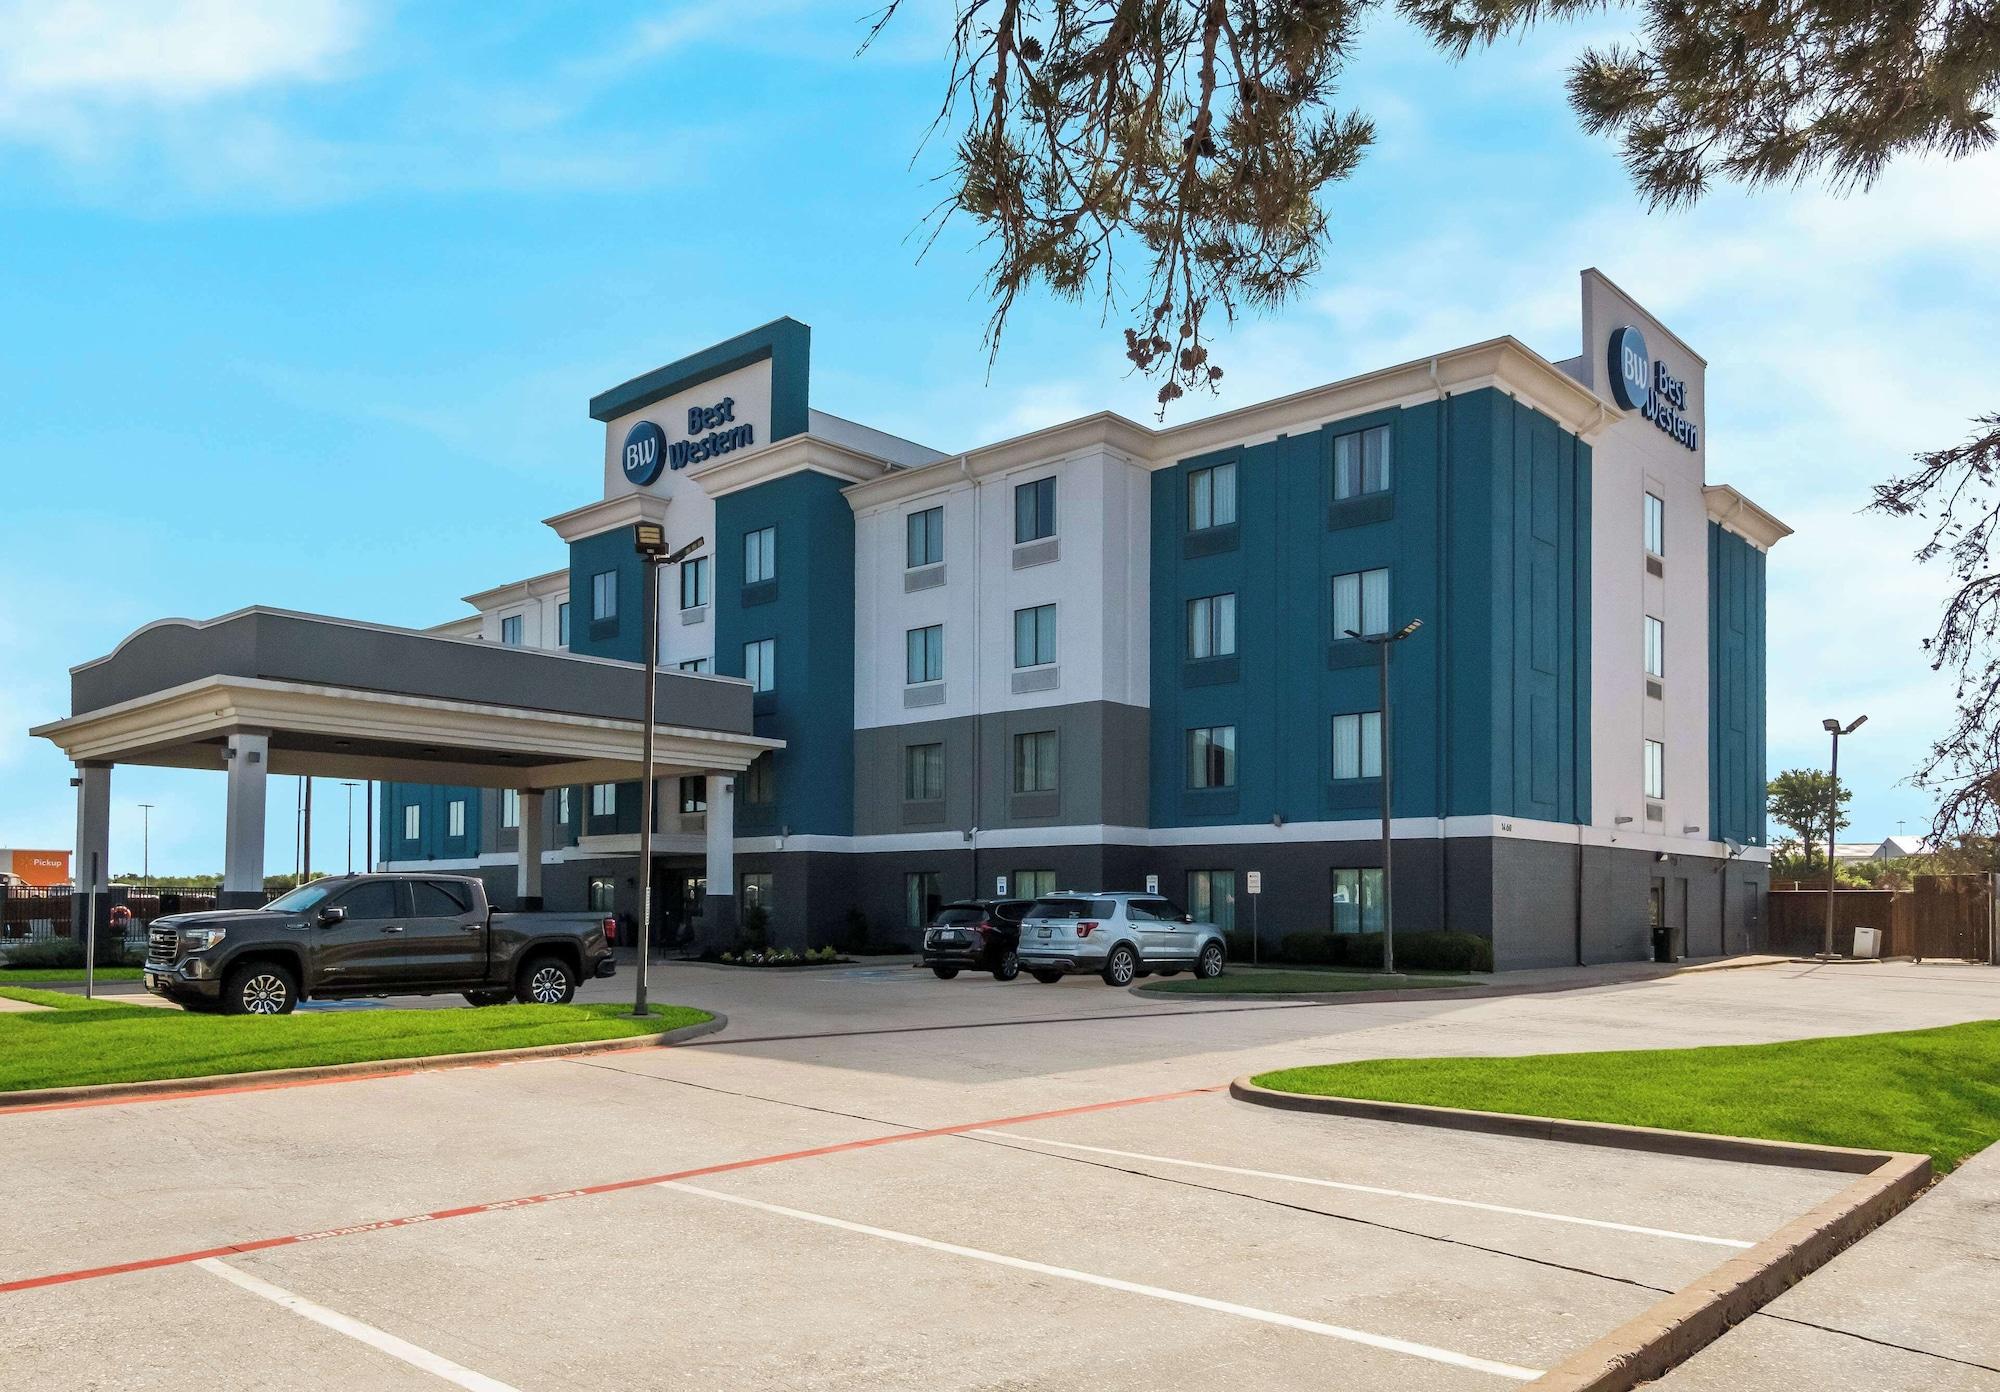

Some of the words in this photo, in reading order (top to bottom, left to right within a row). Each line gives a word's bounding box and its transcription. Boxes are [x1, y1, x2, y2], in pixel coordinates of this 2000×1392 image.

[1624, 347, 1647, 389] BW
[1654, 360, 1687, 411] Best
[688, 397, 735, 435] Best
[1641, 387, 1698, 451] Western
[627, 437, 656, 470] BW
[669, 424, 753, 470] Western
[33, 858, 62, 868] Pickup
